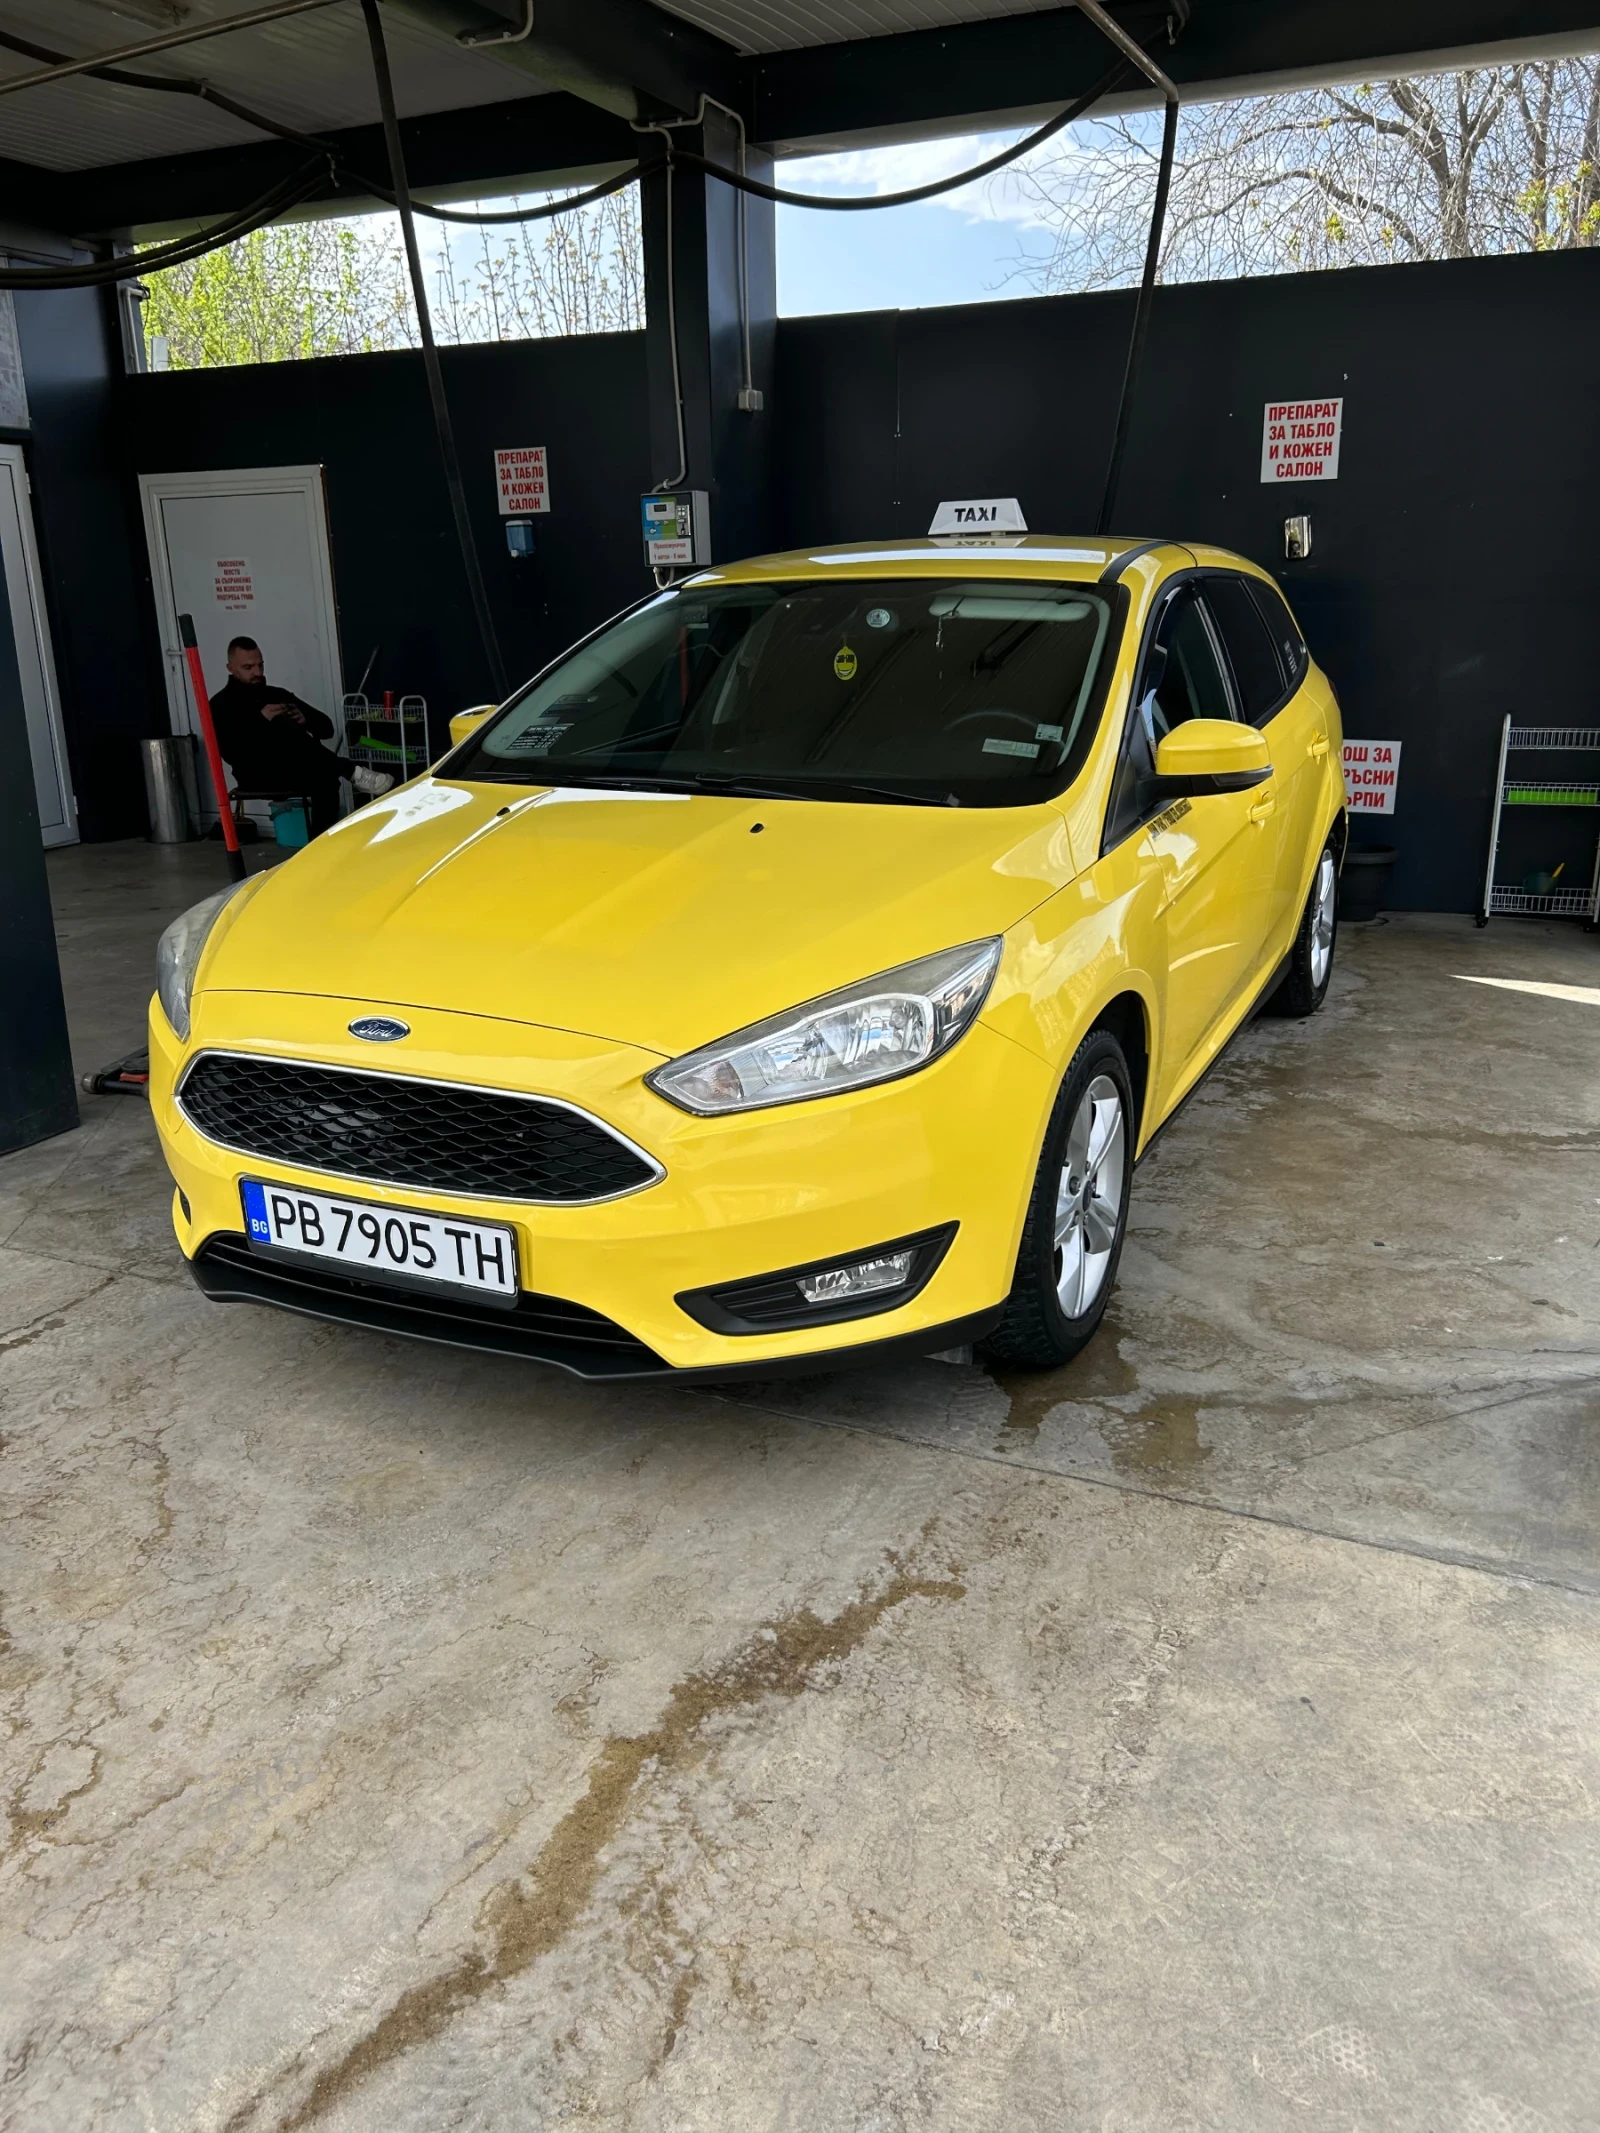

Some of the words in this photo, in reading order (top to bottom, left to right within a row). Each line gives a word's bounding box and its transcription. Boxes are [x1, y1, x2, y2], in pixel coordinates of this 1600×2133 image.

[1268, 402, 1339, 422] ПРЕПАРАТ
[1269, 425, 1286, 441] ЗА
[1290, 421, 1335, 439] ТАБЛО
[497, 450, 544, 465] ПРЕПАРАТ
[1269, 444, 1279, 460] И
[1283, 441, 1333, 459] КОЖЕН
[500, 468, 512, 480] ЗА
[514, 465, 544, 480] ТАБЛО
[1276, 461, 1323, 478] САЛОН
[502, 483, 509, 496] И
[511, 481, 544, 496] КОЖЕН
[509, 497, 541, 511] САЛОН
[954, 506, 997, 523] TAXI
[1343, 746, 1369, 763] ОШ
[1372, 746, 1393, 764] ЗА
[1343, 768, 1395, 786] РЪСНИ
[1346, 791, 1386, 808] РПИ
[359, 1021, 397, 1038] Ford
[251, 1218, 269, 1235] BG
[270, 1194, 325, 1247] PB
[330, 1206, 437, 1269] 7905
[444, 1227, 506, 1285] TH
